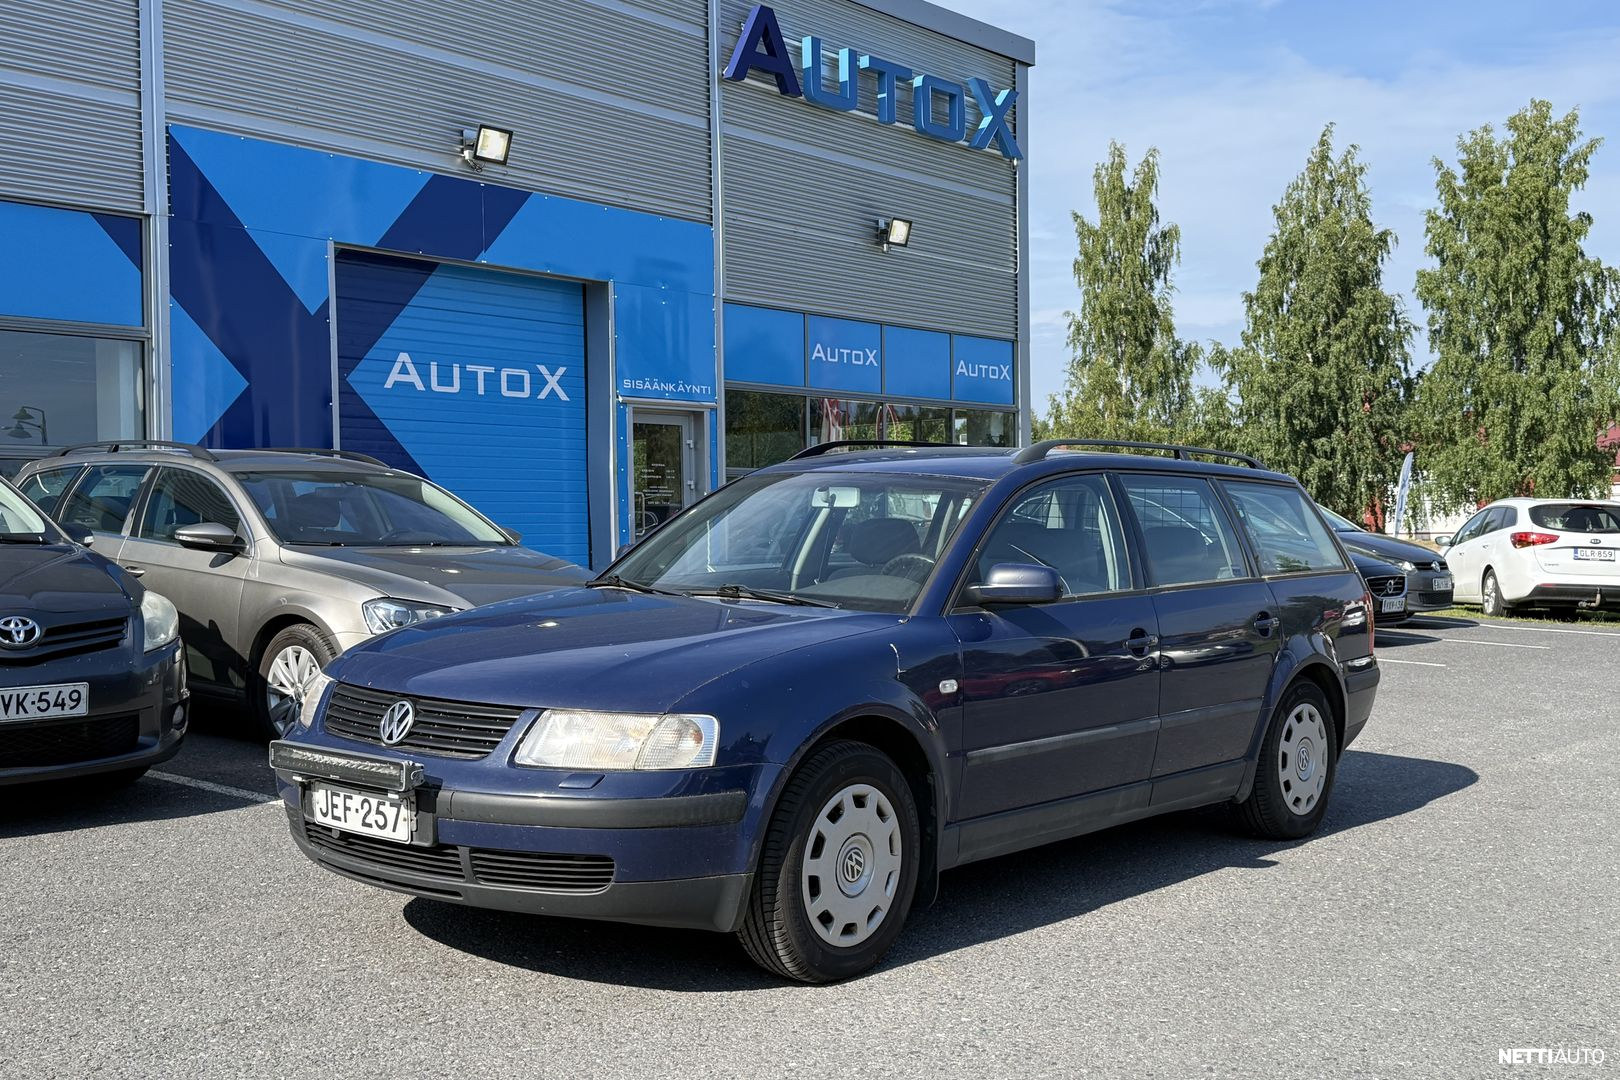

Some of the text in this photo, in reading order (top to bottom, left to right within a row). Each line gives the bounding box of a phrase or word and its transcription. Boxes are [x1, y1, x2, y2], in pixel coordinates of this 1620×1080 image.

[623, 378, 711, 394] SISÄÄNKÄYNTI
[1579, 549, 1613, 558] GLR-859
[319, 789, 402, 833] JEF-257
